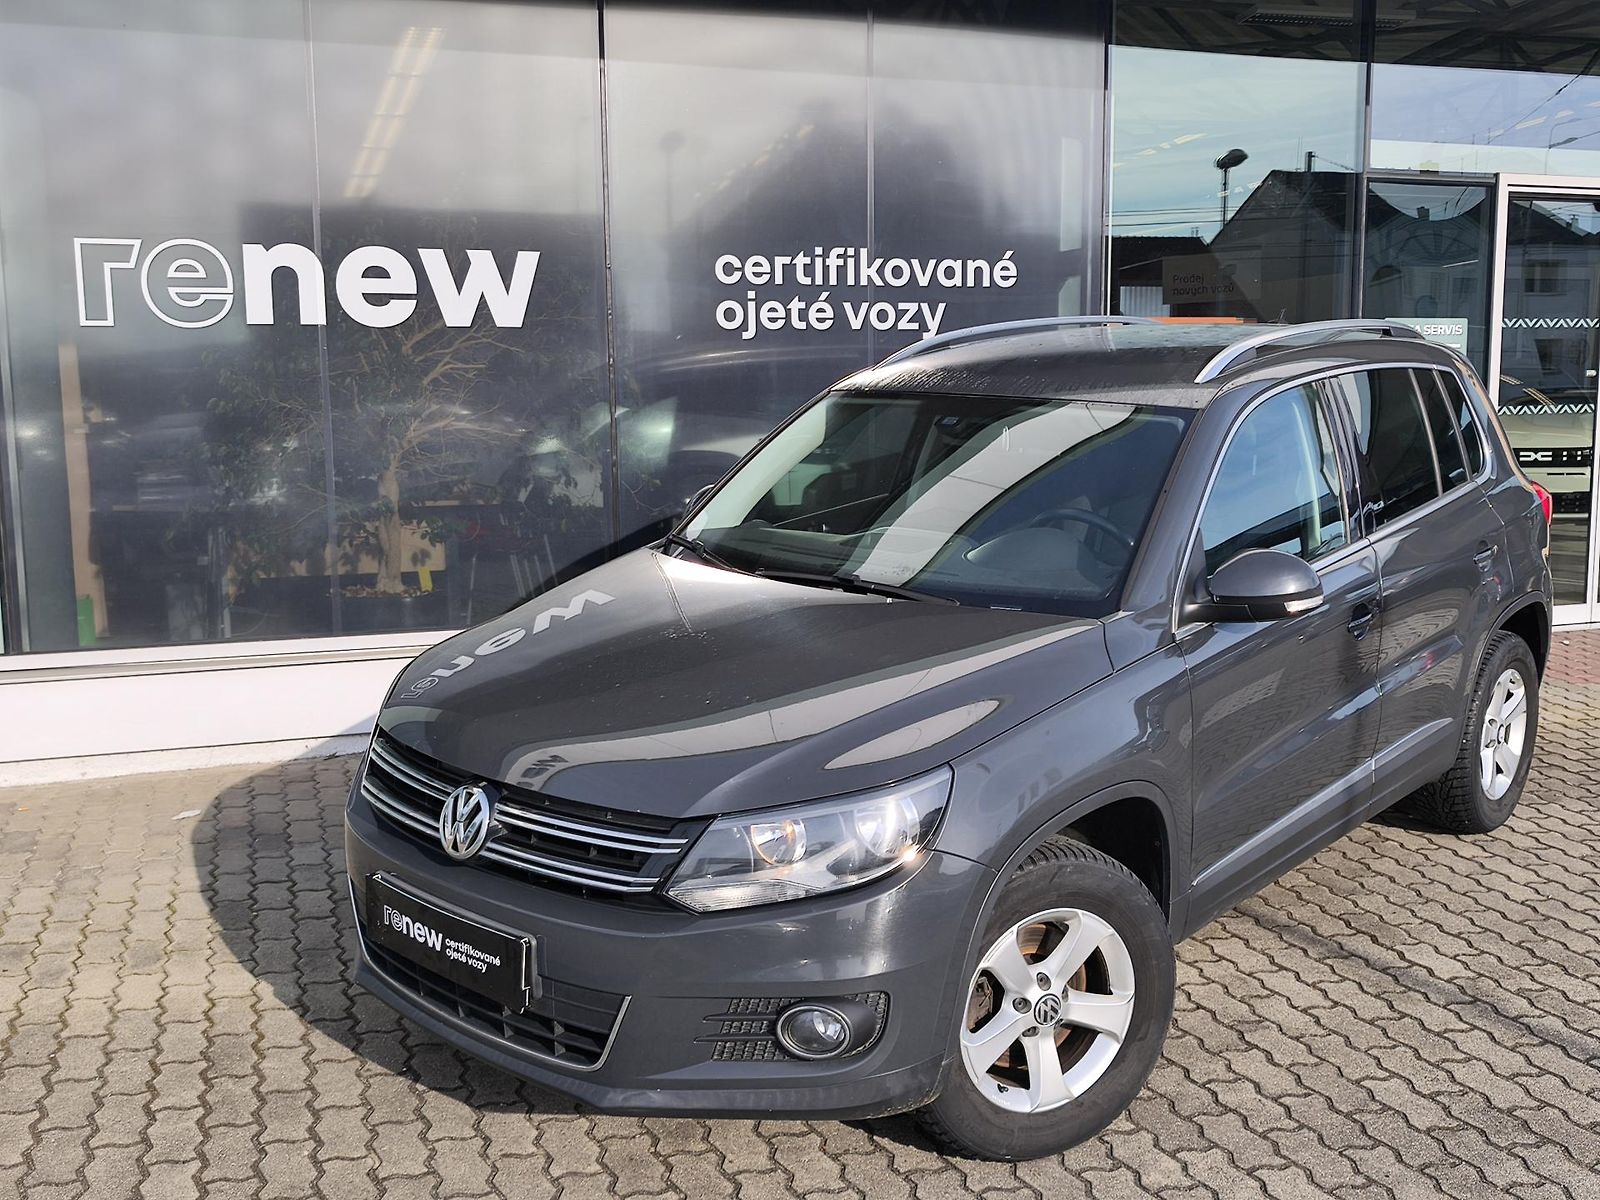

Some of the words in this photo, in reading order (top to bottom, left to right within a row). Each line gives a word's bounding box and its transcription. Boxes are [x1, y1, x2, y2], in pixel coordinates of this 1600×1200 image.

[73, 237, 541, 328] renew
[714, 246, 1018, 288] certifikované
[1172, 273, 1205, 285] Prodej
[715, 290, 835, 340] ojeté
[842, 301, 947, 341] vozy
[1423, 324, 1463, 336] SERVIS
[383, 905, 443, 952] renew
[445, 938, 501, 966] certifikované
[445, 948, 467, 963] ojeté
[467, 956, 488, 973] vozy
